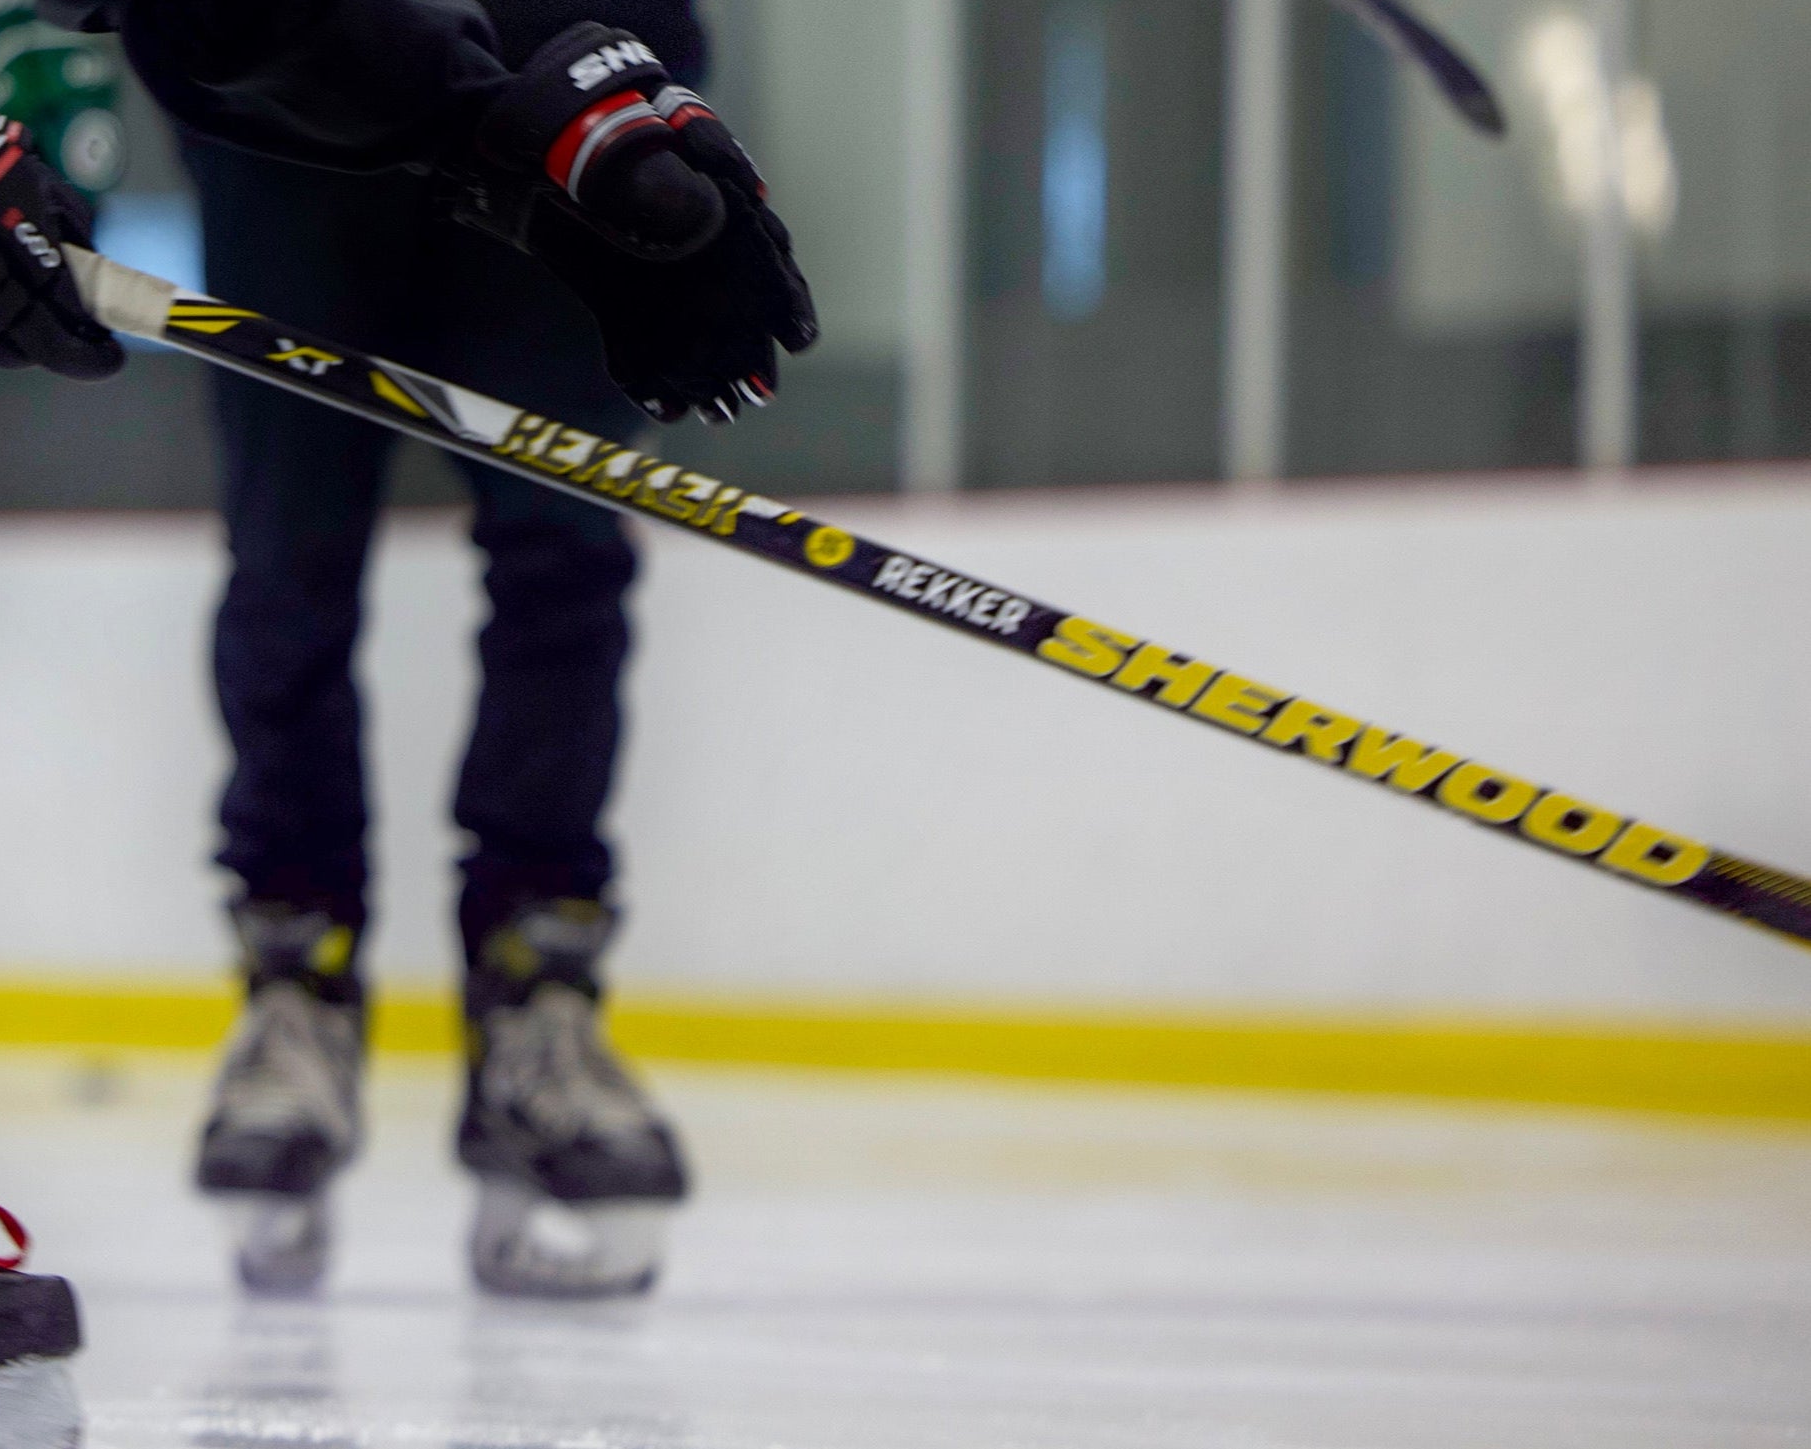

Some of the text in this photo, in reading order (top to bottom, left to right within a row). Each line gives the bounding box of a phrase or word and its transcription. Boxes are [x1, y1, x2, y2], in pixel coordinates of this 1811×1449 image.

[267, 337, 345, 376] XT
[872, 554, 1032, 636] REKKER
[1036, 613, 1717, 891] SHERWOOD
